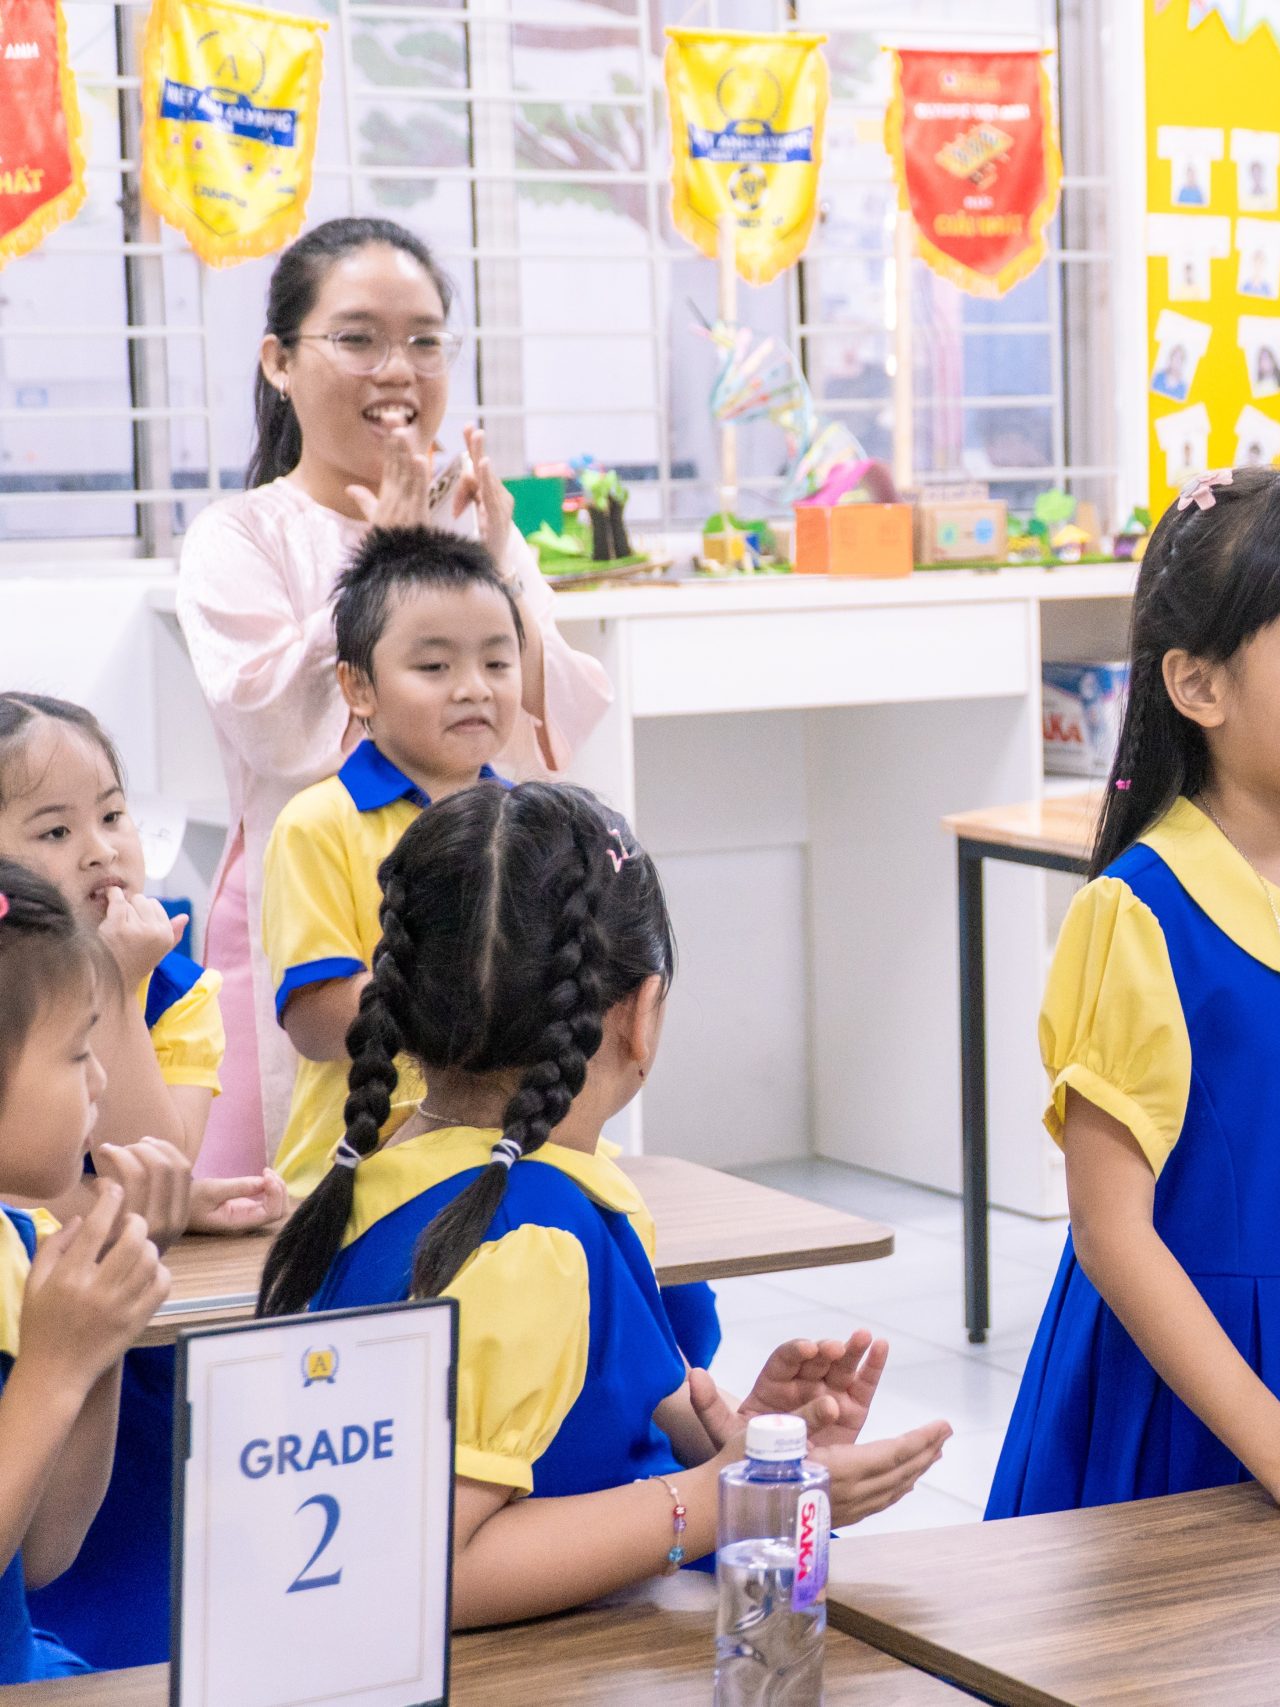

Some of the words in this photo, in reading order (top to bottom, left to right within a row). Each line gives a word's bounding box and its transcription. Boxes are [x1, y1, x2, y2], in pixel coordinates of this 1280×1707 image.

[240, 1418, 394, 1480] GRADE
[286, 1493, 343, 1594] 2
[798, 1502, 816, 1582] SAKA
